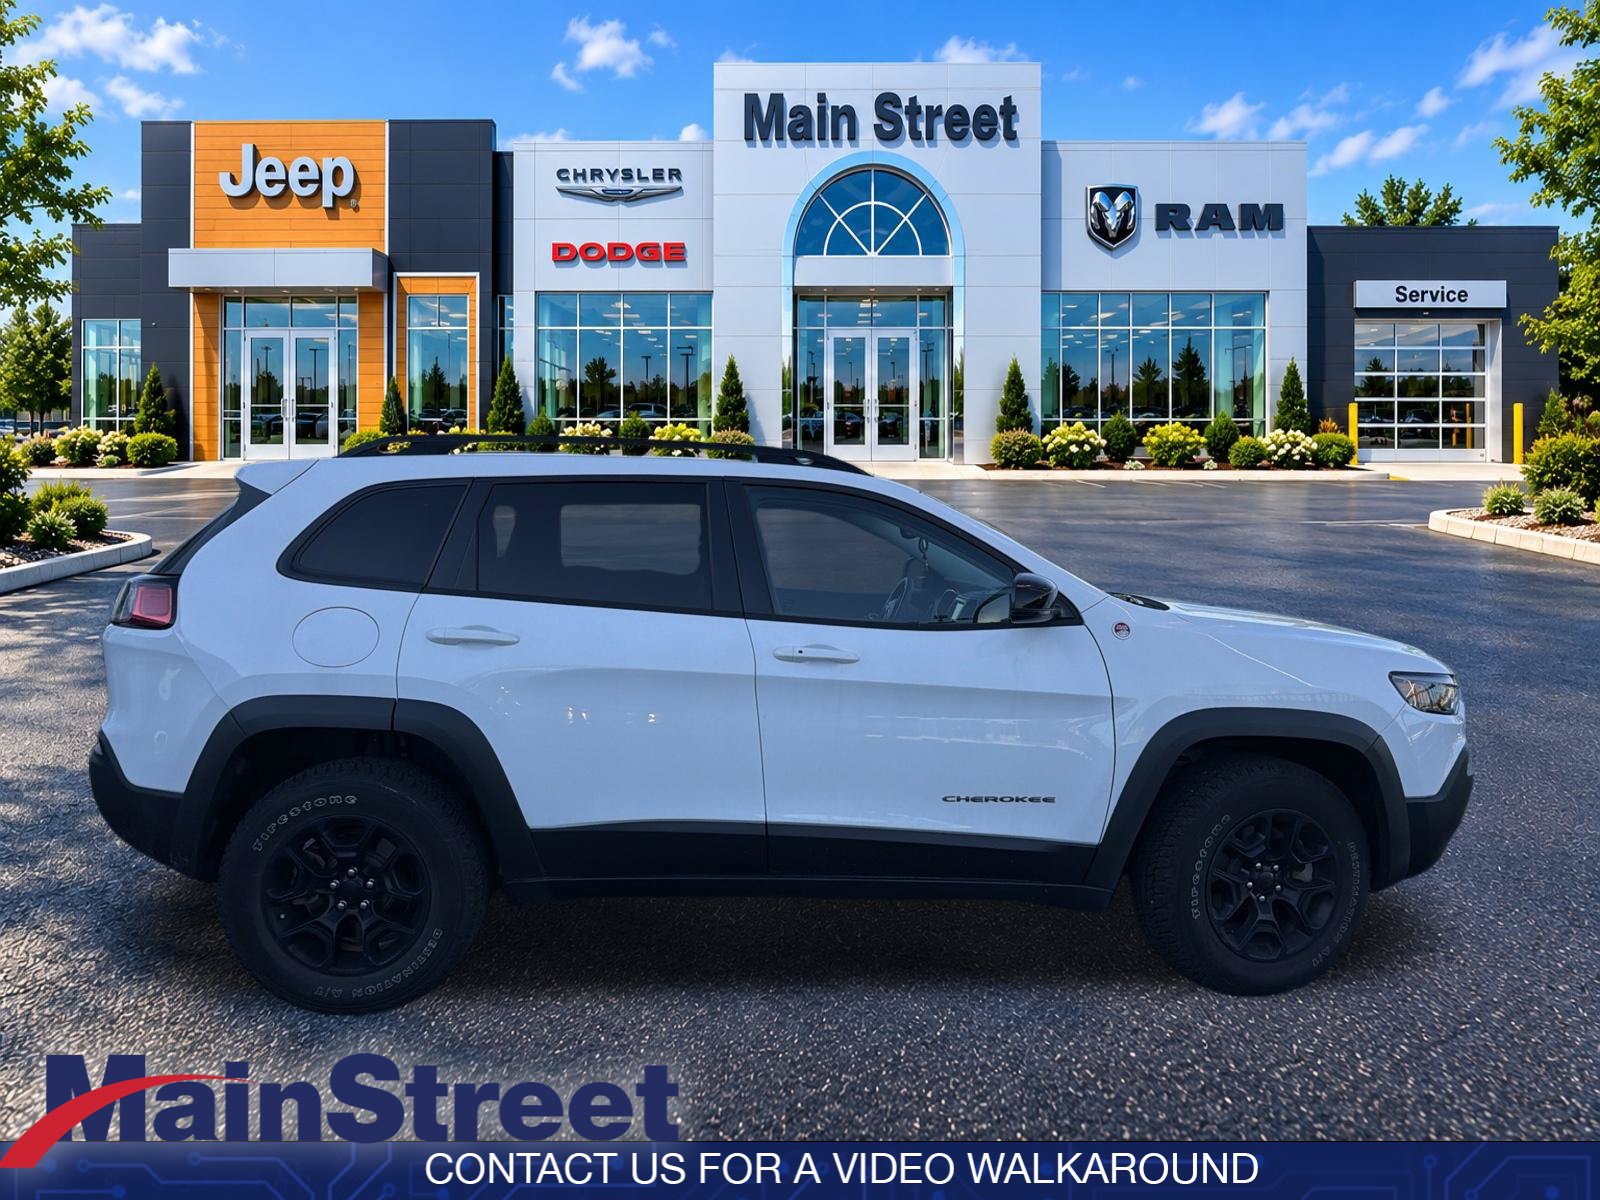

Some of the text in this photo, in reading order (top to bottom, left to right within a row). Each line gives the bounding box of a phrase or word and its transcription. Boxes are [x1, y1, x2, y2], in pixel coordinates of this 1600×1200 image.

[743, 91, 1018, 143] Main Street
[218, 143, 356, 209] Jeep
[556, 167, 682, 184] CHRYSLER
[1154, 203, 1285, 232] RAM
[551, 241, 686, 262] DODGE
[1395, 285, 1469, 303] Service
[942, 795, 1056, 804] CHEROKEE
